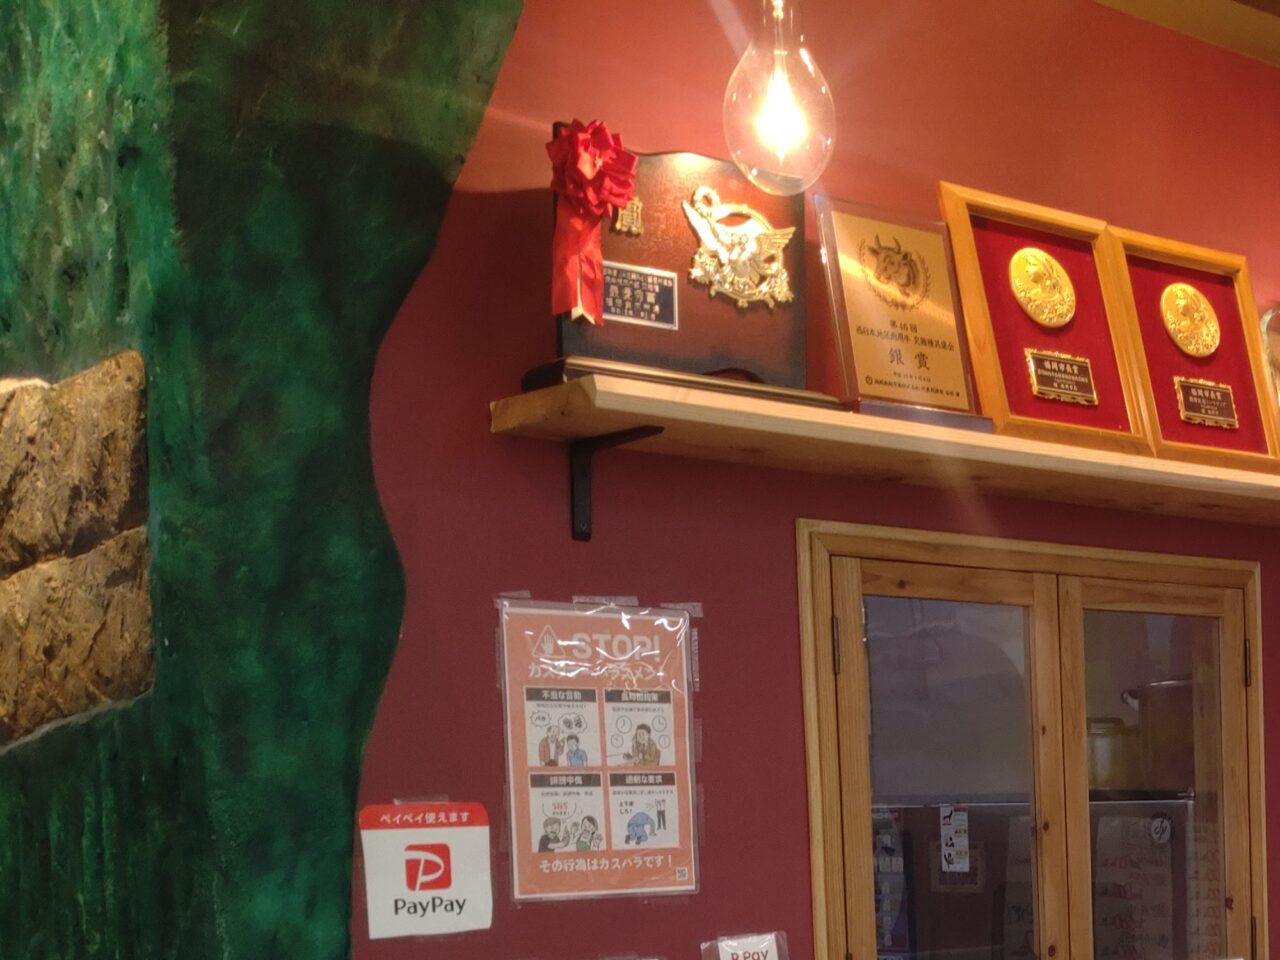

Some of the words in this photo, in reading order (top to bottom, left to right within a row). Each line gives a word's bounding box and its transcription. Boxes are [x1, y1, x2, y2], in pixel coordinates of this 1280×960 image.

[380, 811, 470, 825] ペイペイ使えます
[394, 896, 467, 918] PayPay
